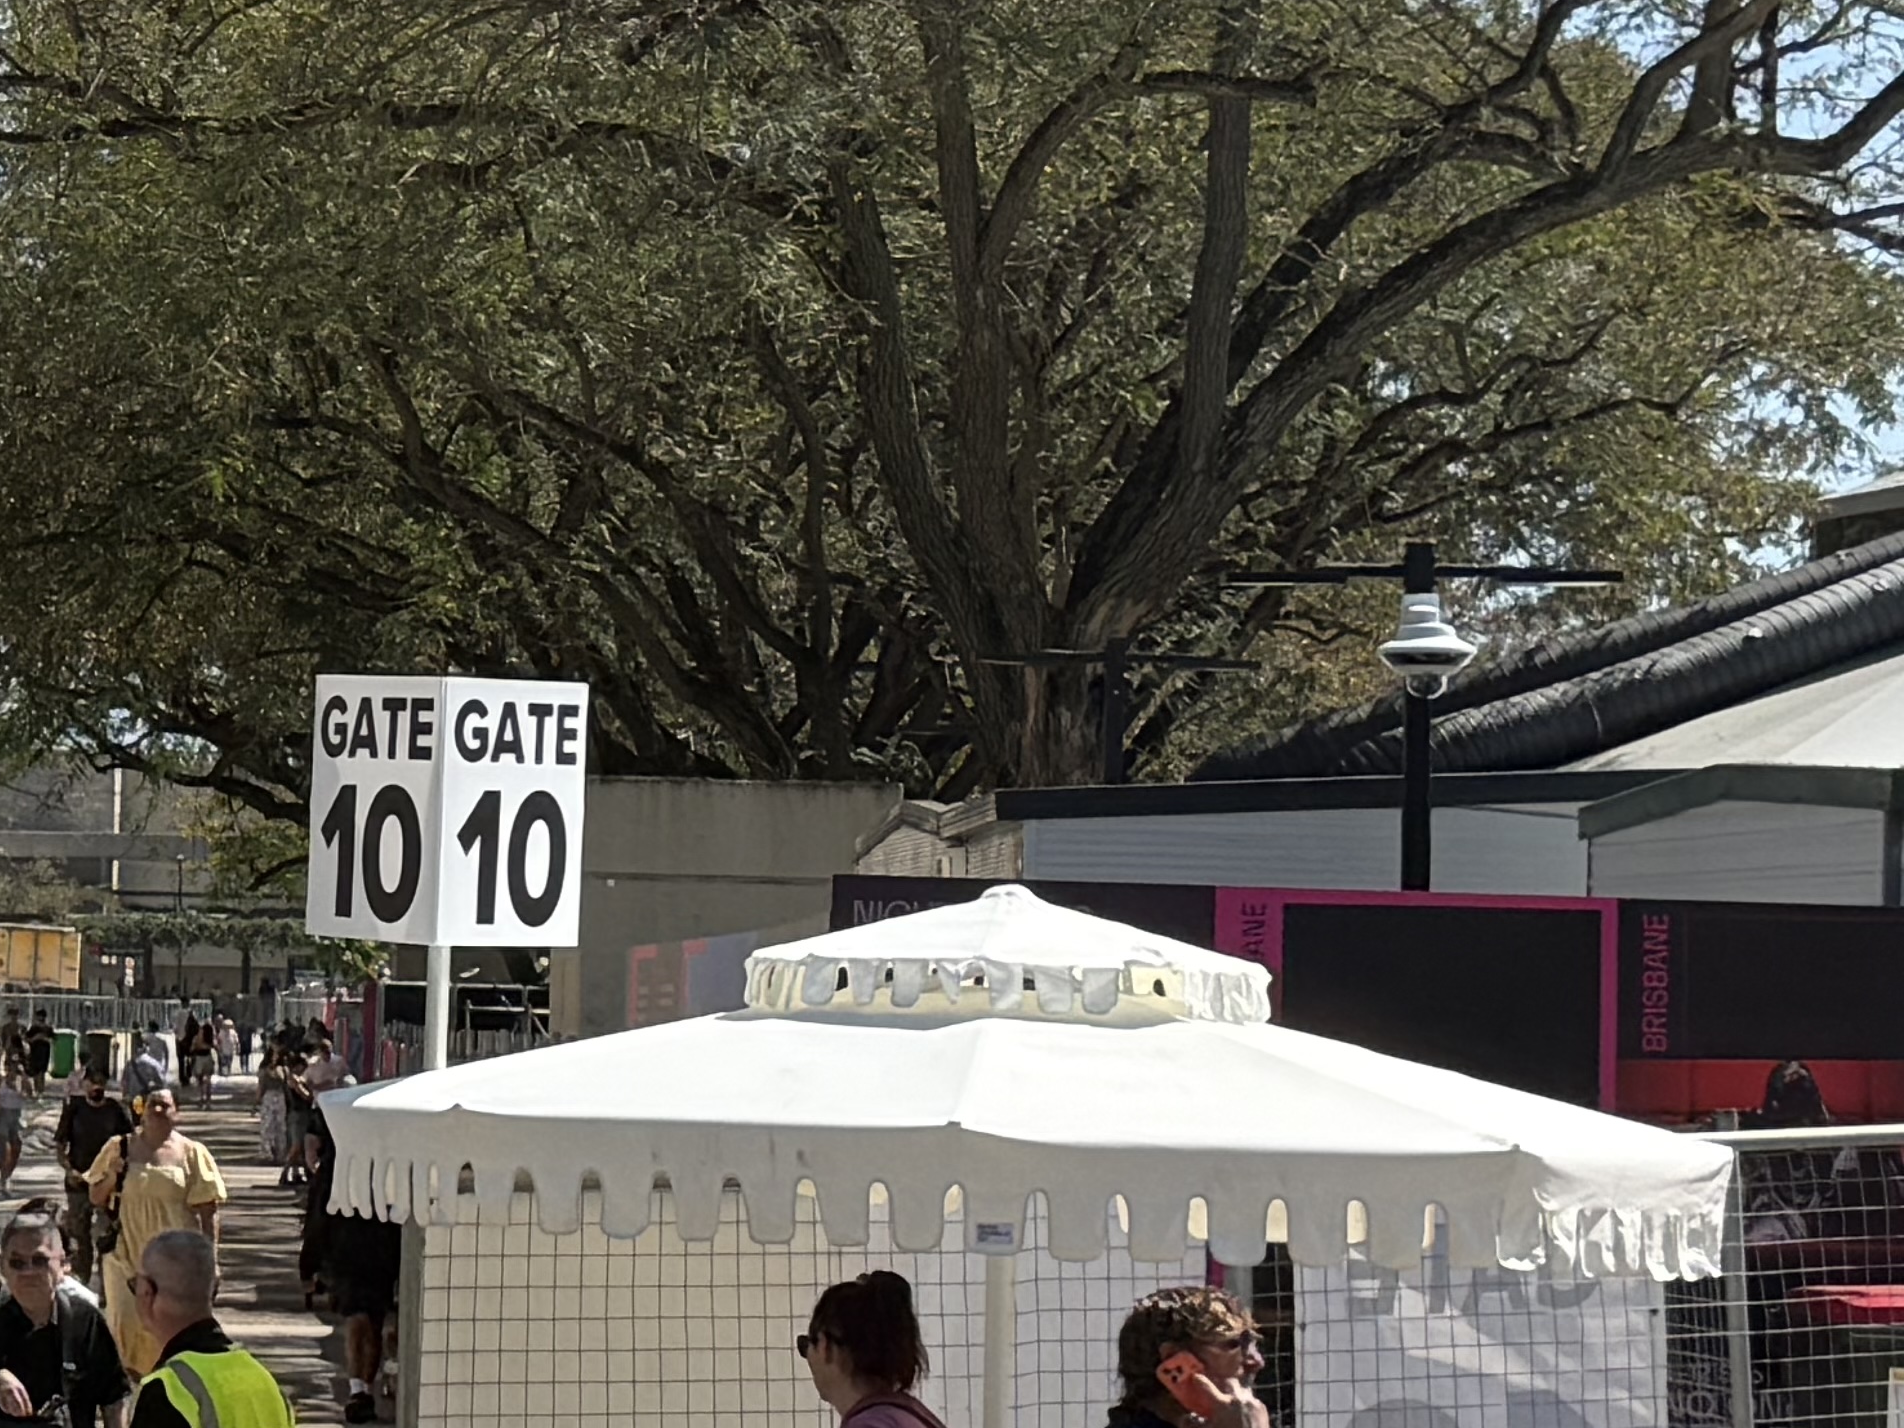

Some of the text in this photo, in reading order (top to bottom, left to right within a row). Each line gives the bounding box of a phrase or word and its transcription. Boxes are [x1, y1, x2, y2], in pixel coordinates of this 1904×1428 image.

[321, 695, 435, 760] GATE
[454, 699, 580, 765] GATE
[321, 784, 422, 924] 10
[456, 790, 567, 928] 10
[1642, 913, 1671, 1053] BRISBANE
